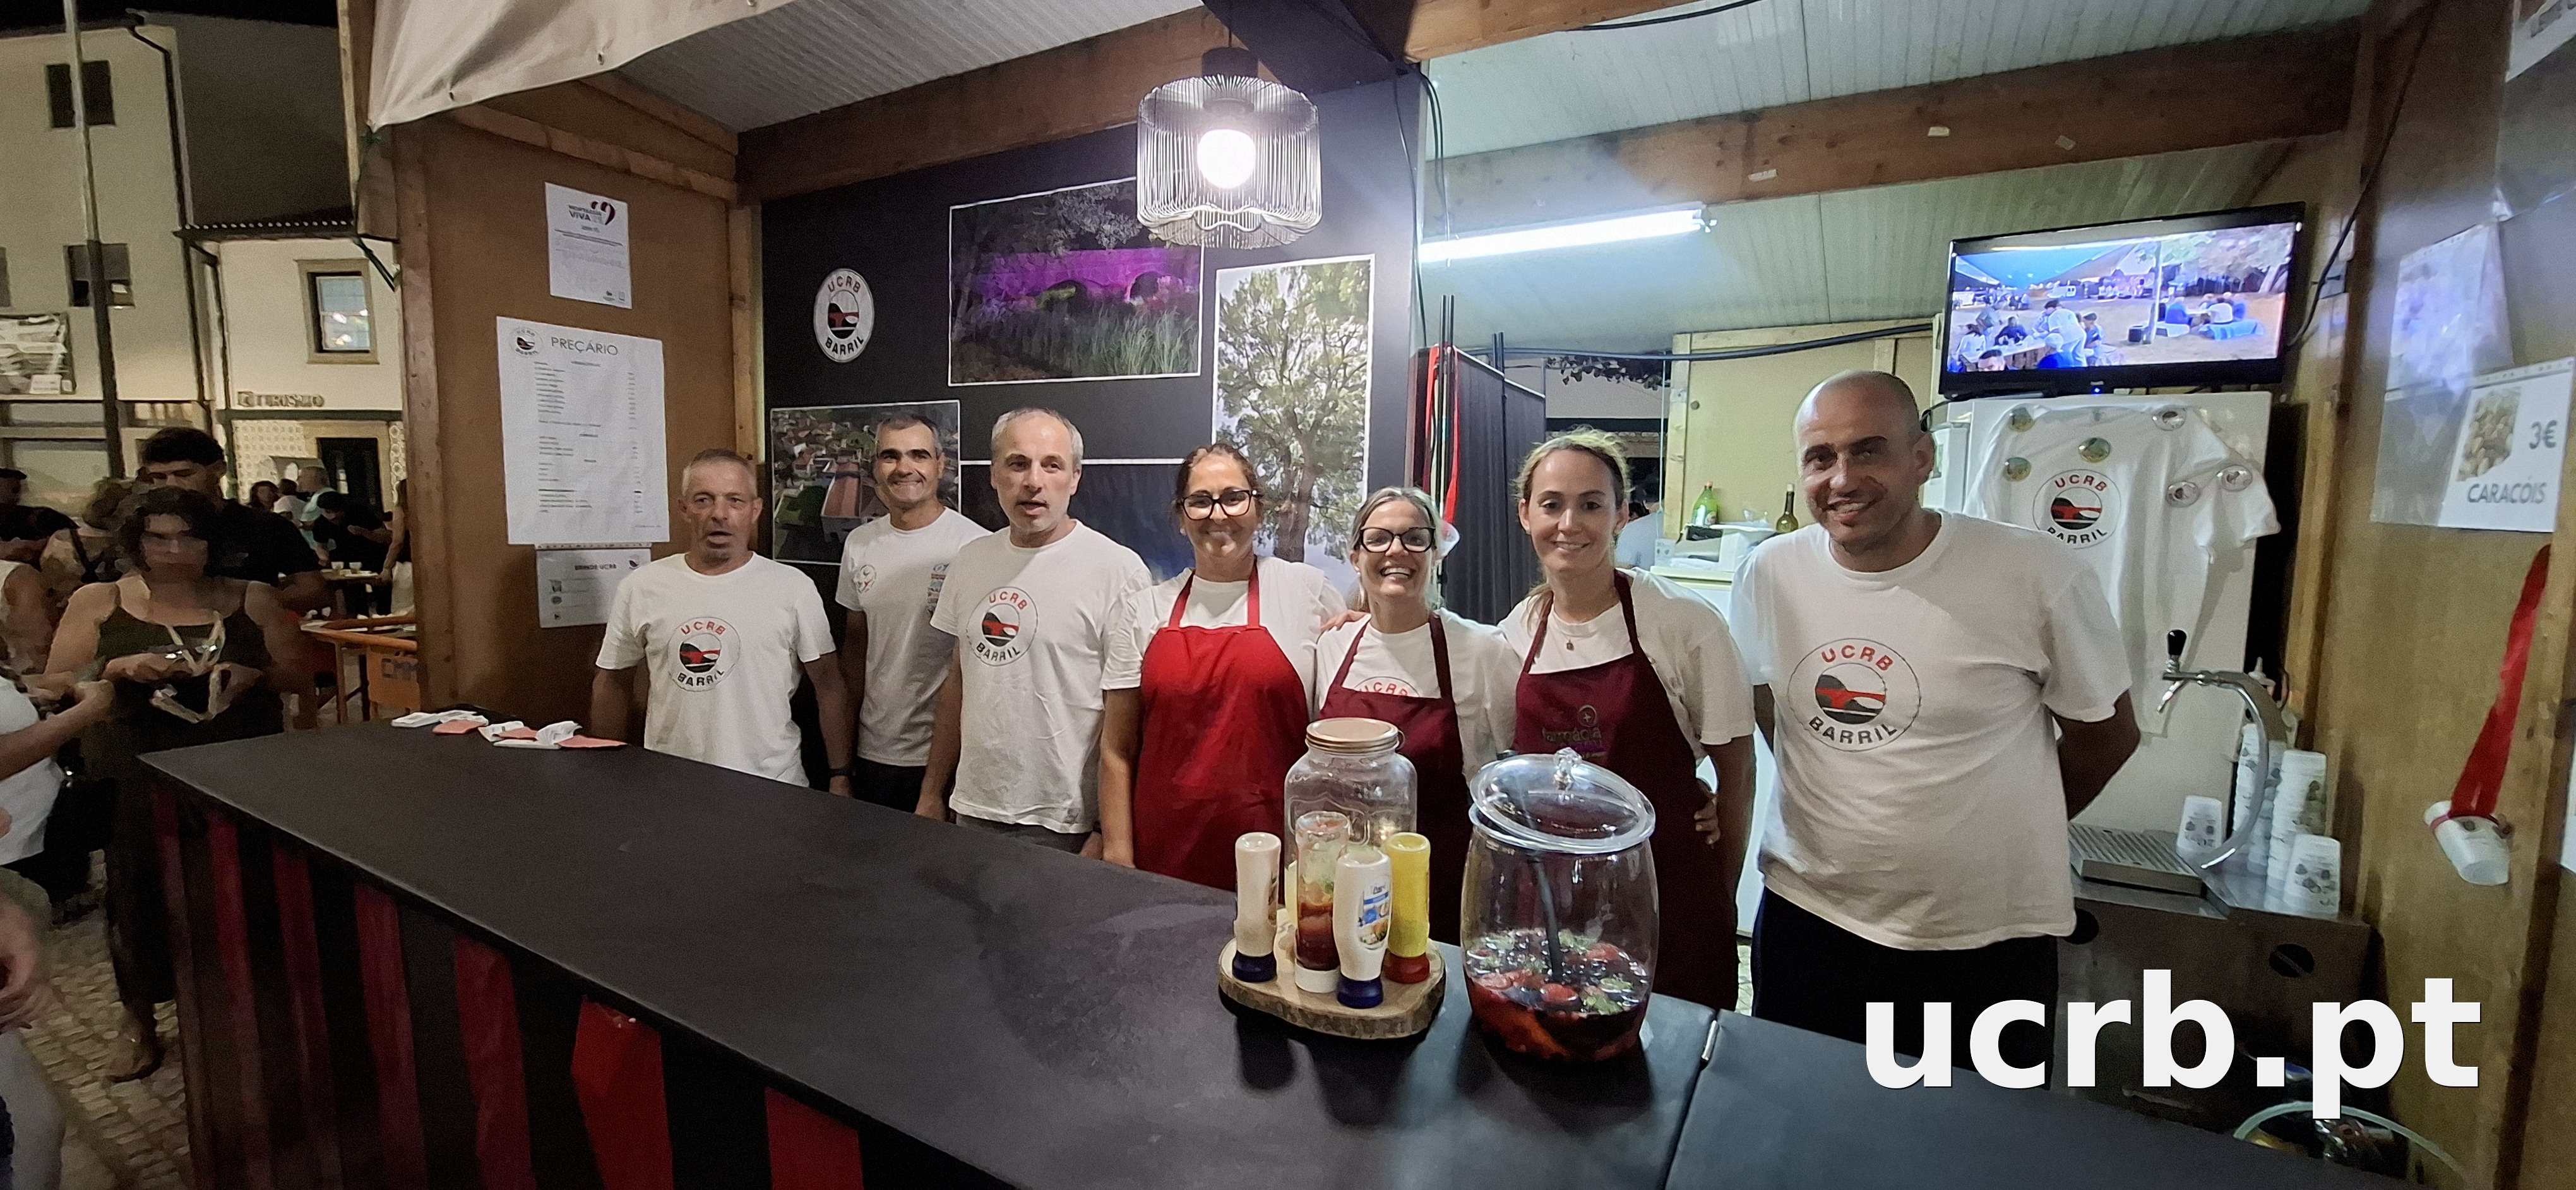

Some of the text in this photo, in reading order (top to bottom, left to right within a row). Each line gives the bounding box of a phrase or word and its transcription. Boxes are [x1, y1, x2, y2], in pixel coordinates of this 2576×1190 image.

[568, 210, 592, 221] VIVA
[828, 275, 861, 293] UCRB
[551, 336, 618, 356] PREÇÁRIO
[825, 336, 864, 355] BARRIL
[2529, 419, 2558, 450] 3€
[2054, 474, 2108, 492] UCRB
[2467, 476, 2547, 504] CARACÓIS
[989, 591, 1027, 610] UCRB
[681, 621, 726, 635] UCRB
[976, 642, 1021, 662] BARRIL
[1821, 645, 1894, 671] UCRB
[677, 670, 725, 687] BARRIL
[1809, 716, 1898, 745] BARRIL
